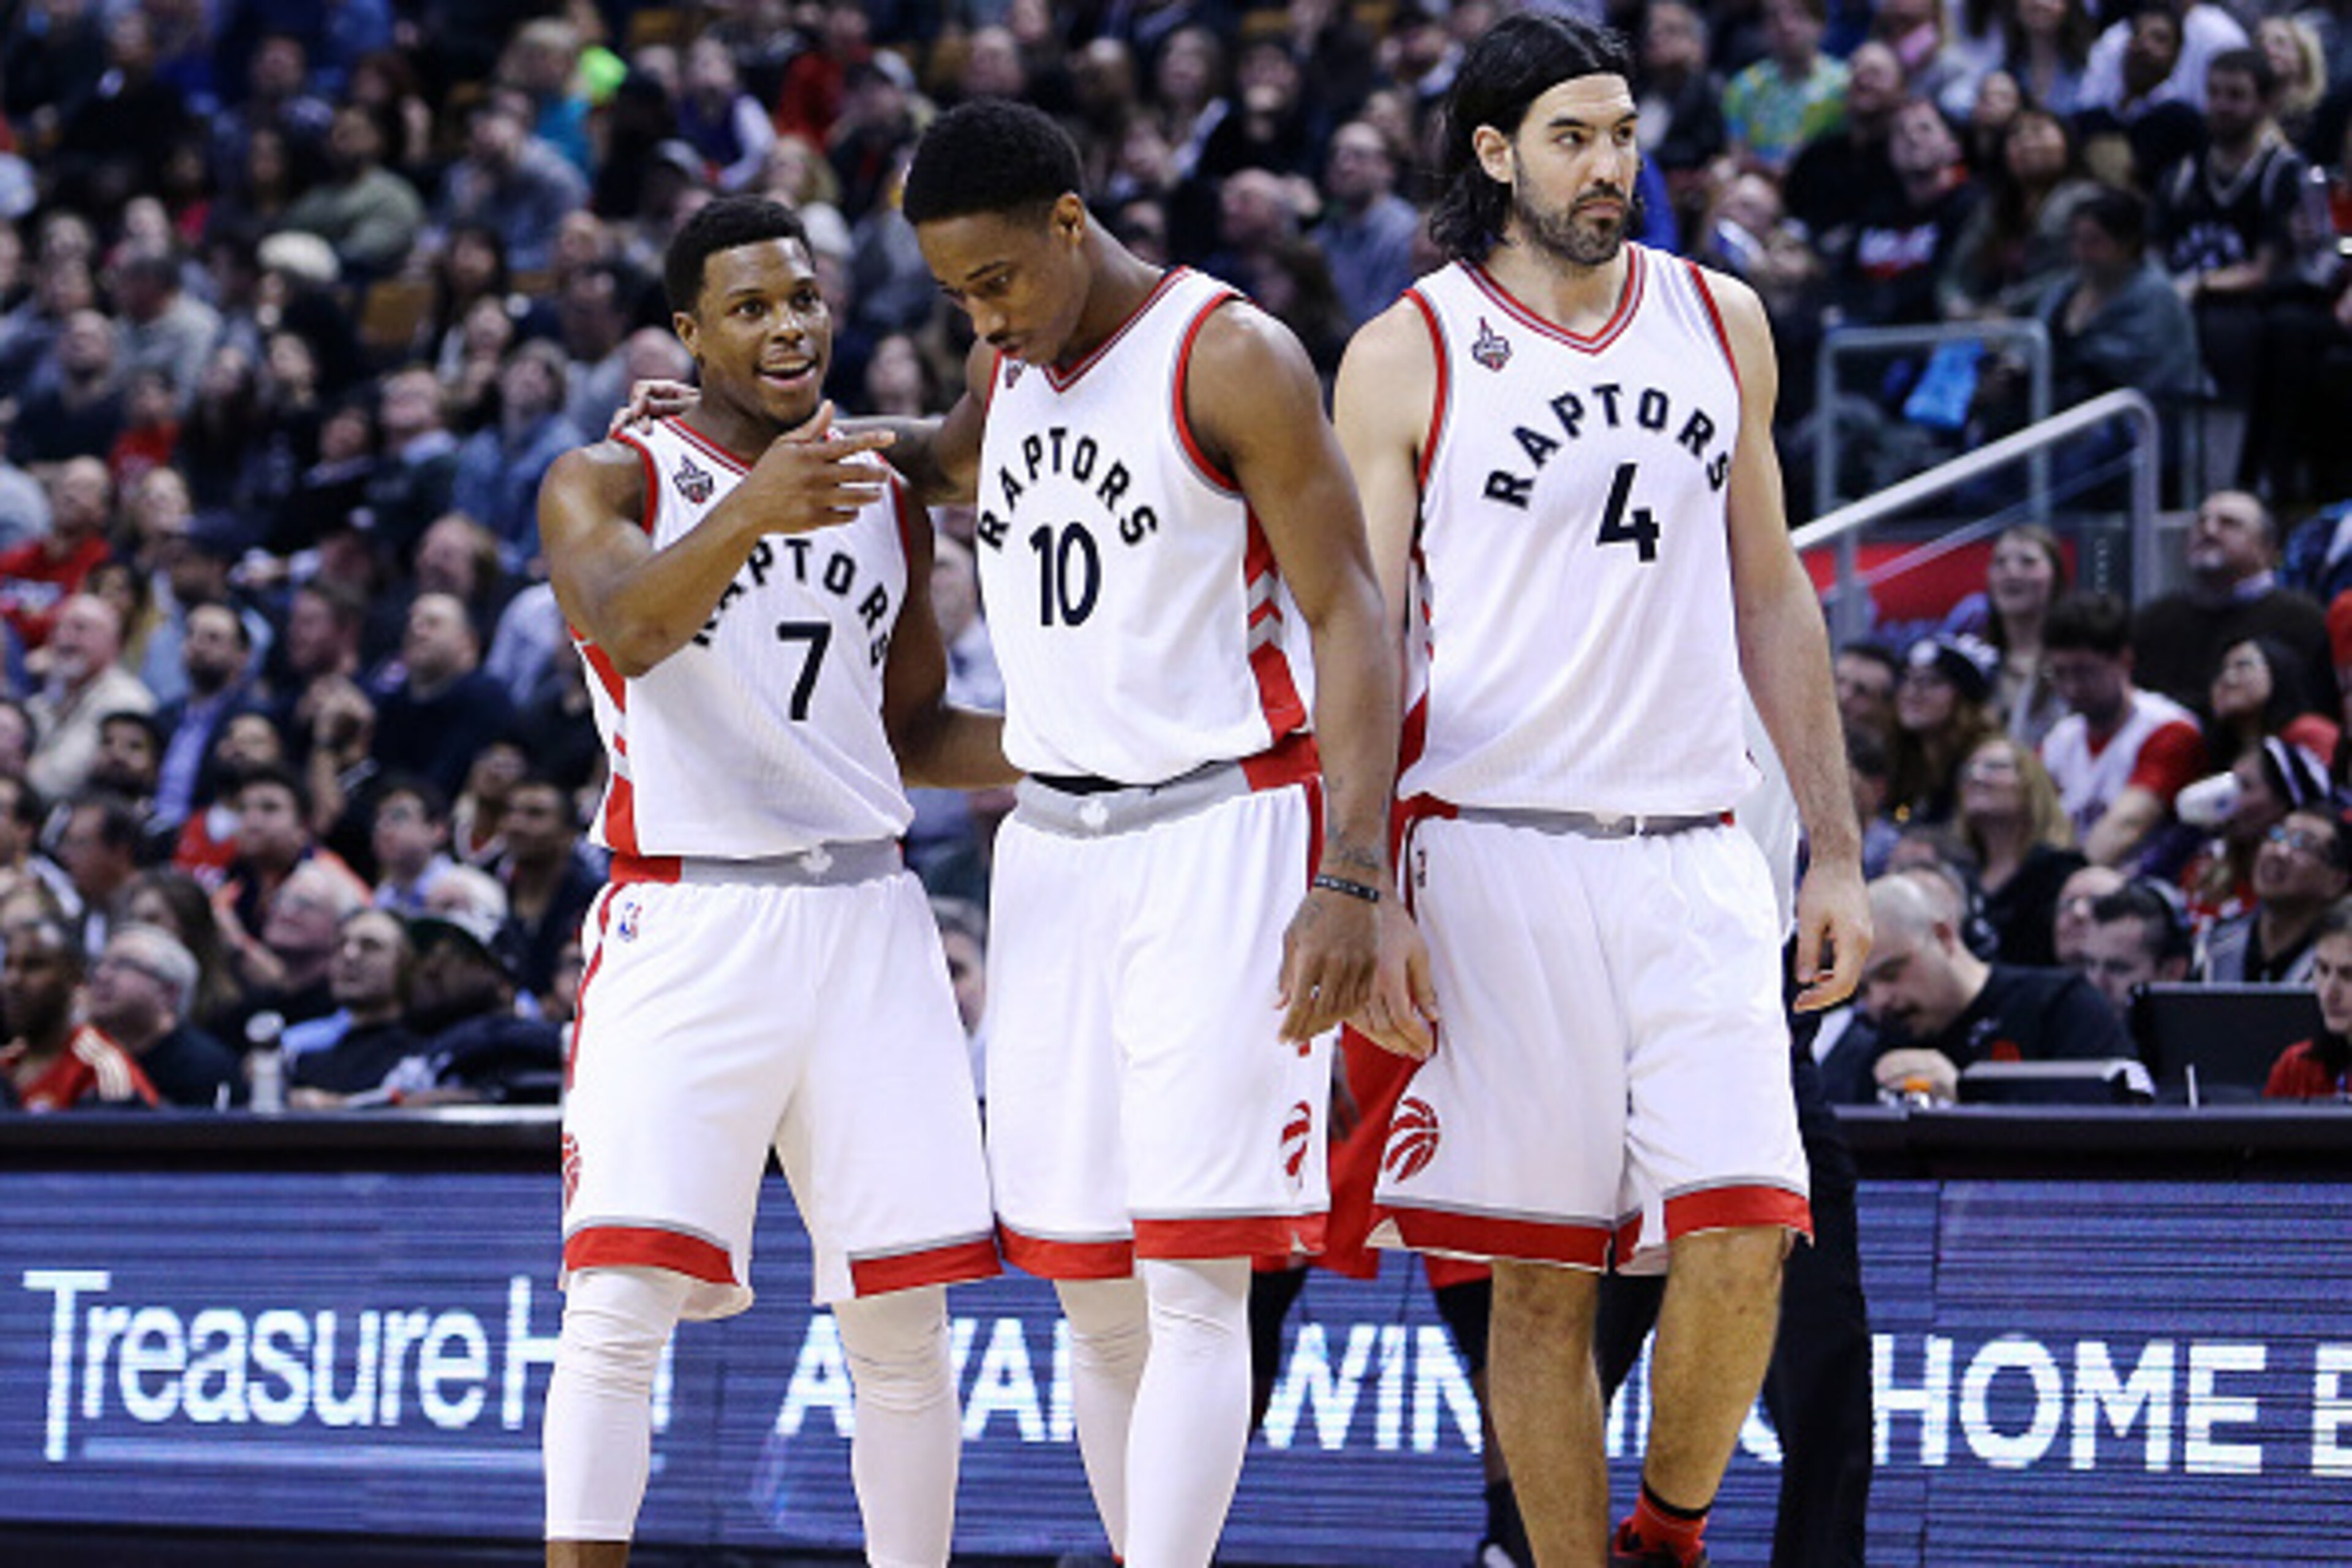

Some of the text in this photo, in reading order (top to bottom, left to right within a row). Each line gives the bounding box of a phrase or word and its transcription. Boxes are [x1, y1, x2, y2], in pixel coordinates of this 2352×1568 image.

[978, 428, 1156, 550] RAPTORS
[1480, 383, 1732, 510] RAPTORS
[1596, 462, 1660, 562] 4
[1029, 522, 1101, 627] 10
[776, 621, 832, 722] 7
[1872, 1334, 2266, 1472] HOME
